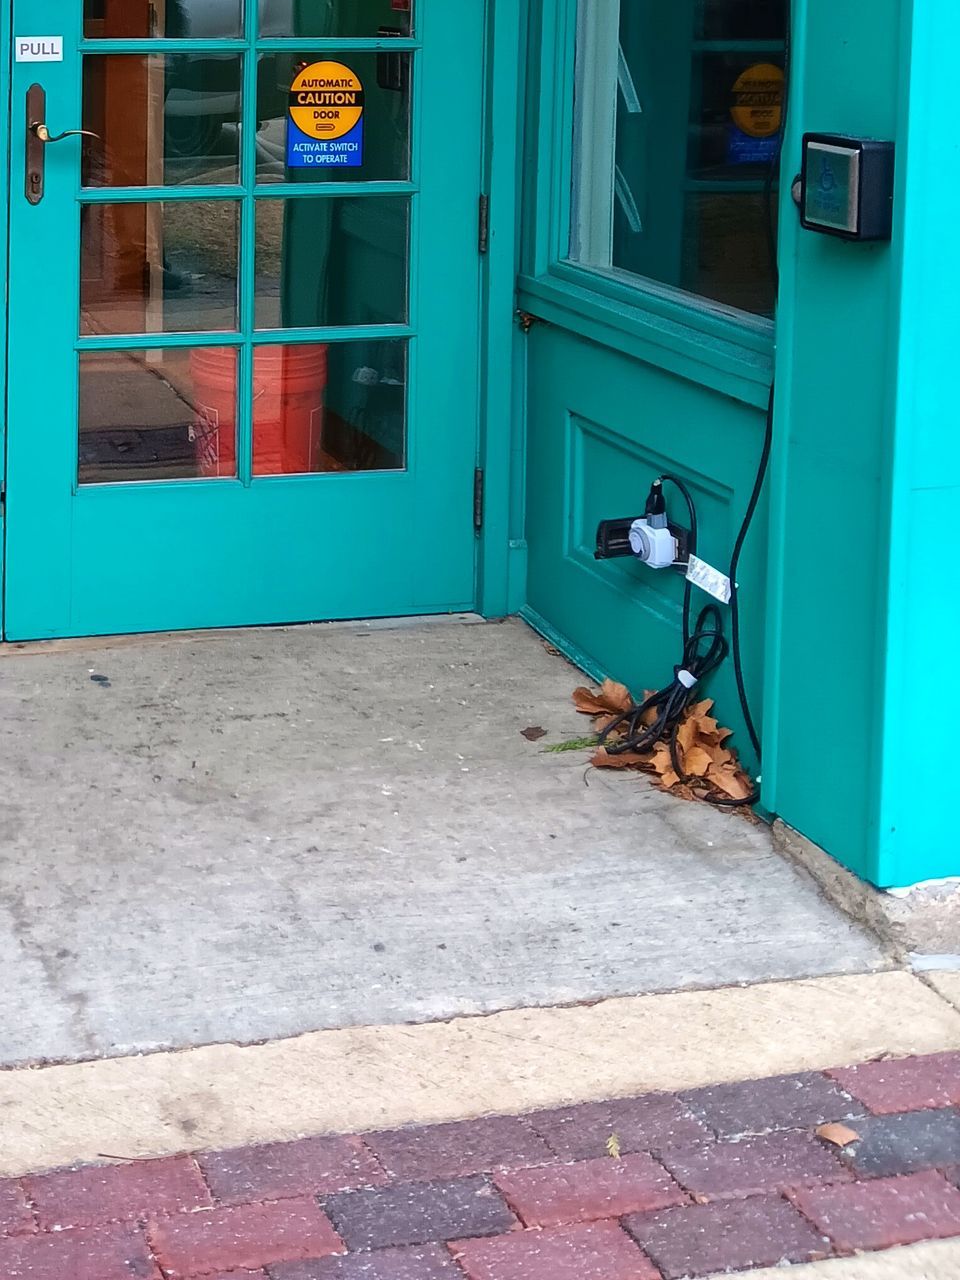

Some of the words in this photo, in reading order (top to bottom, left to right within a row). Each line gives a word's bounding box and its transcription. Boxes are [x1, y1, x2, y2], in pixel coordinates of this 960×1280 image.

[20, 42, 60, 56] PULL
[300, 79, 353, 88] AUTOMATIC
[297, 92, 356, 104] CAUTION
[313, 110, 340, 119] DOOR
[293, 143, 328, 151] ACTIVATE
[330, 143, 358, 151] SWITCH
[303, 154, 314, 163] TO
[315, 154, 348, 163] OPERATE
